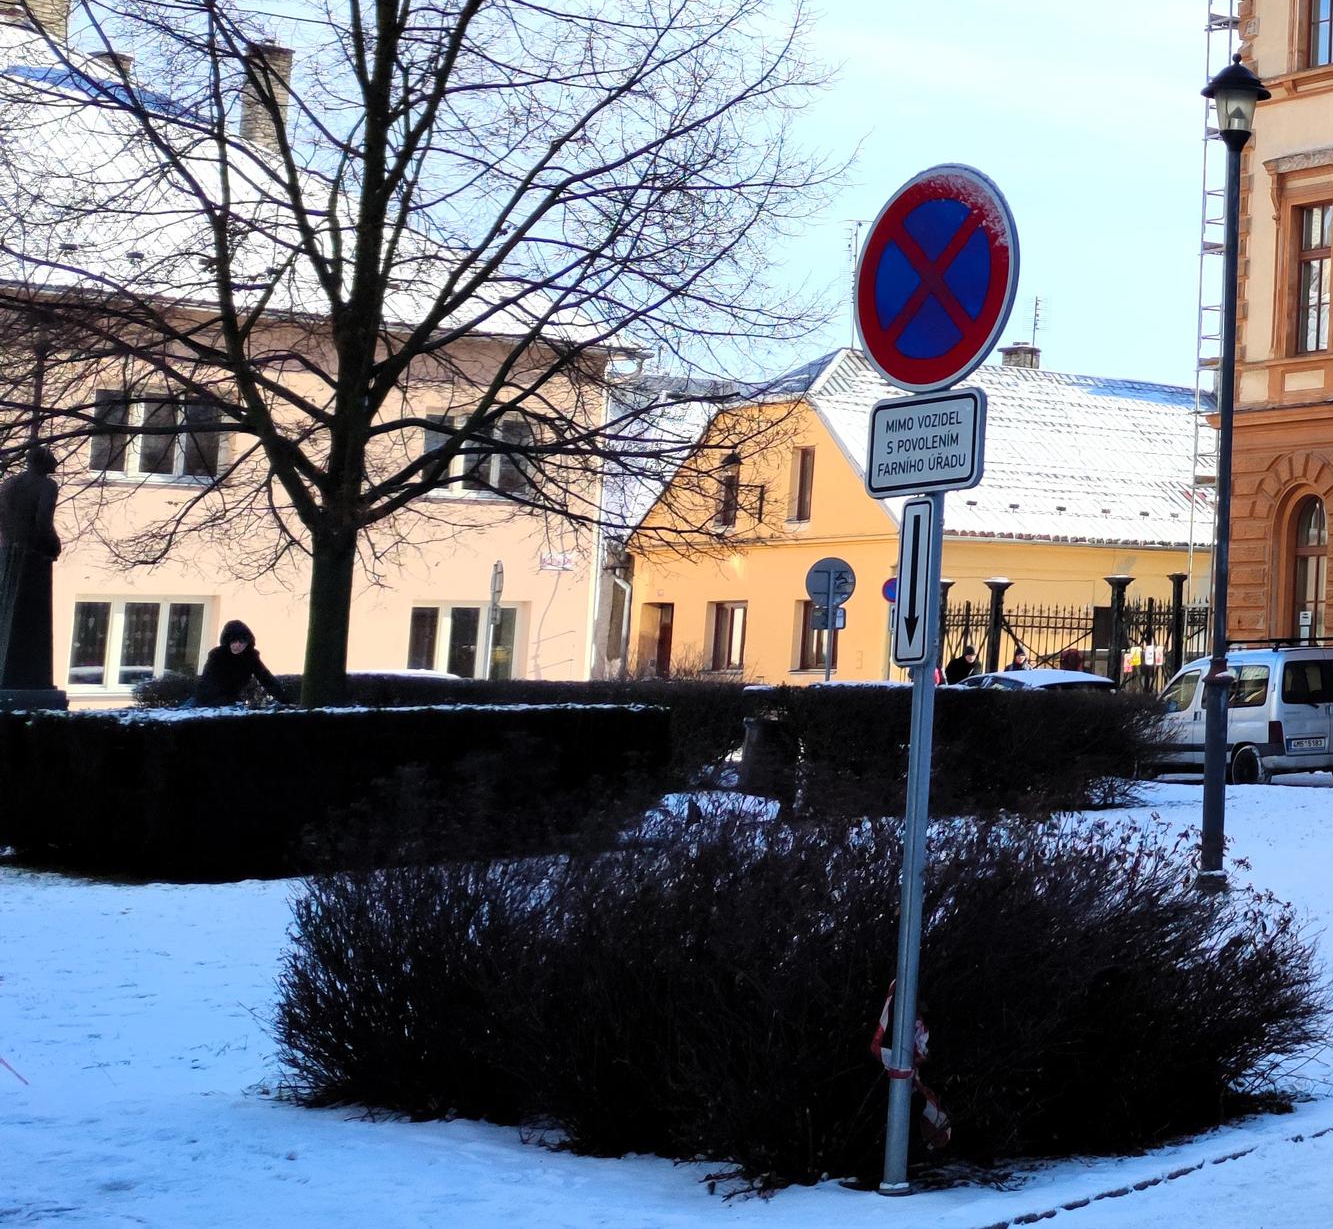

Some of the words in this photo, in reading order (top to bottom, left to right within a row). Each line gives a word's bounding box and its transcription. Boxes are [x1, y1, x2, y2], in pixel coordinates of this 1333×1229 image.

[886, 417, 914, 433] MIMO
[918, 411, 962, 429] VOZIDEL
[886, 440, 894, 455] S
[897, 429, 959, 453] POVOLENÍM
[877, 456, 924, 477] FARNÍHO
[928, 452, 966, 471] ÚŘADU
